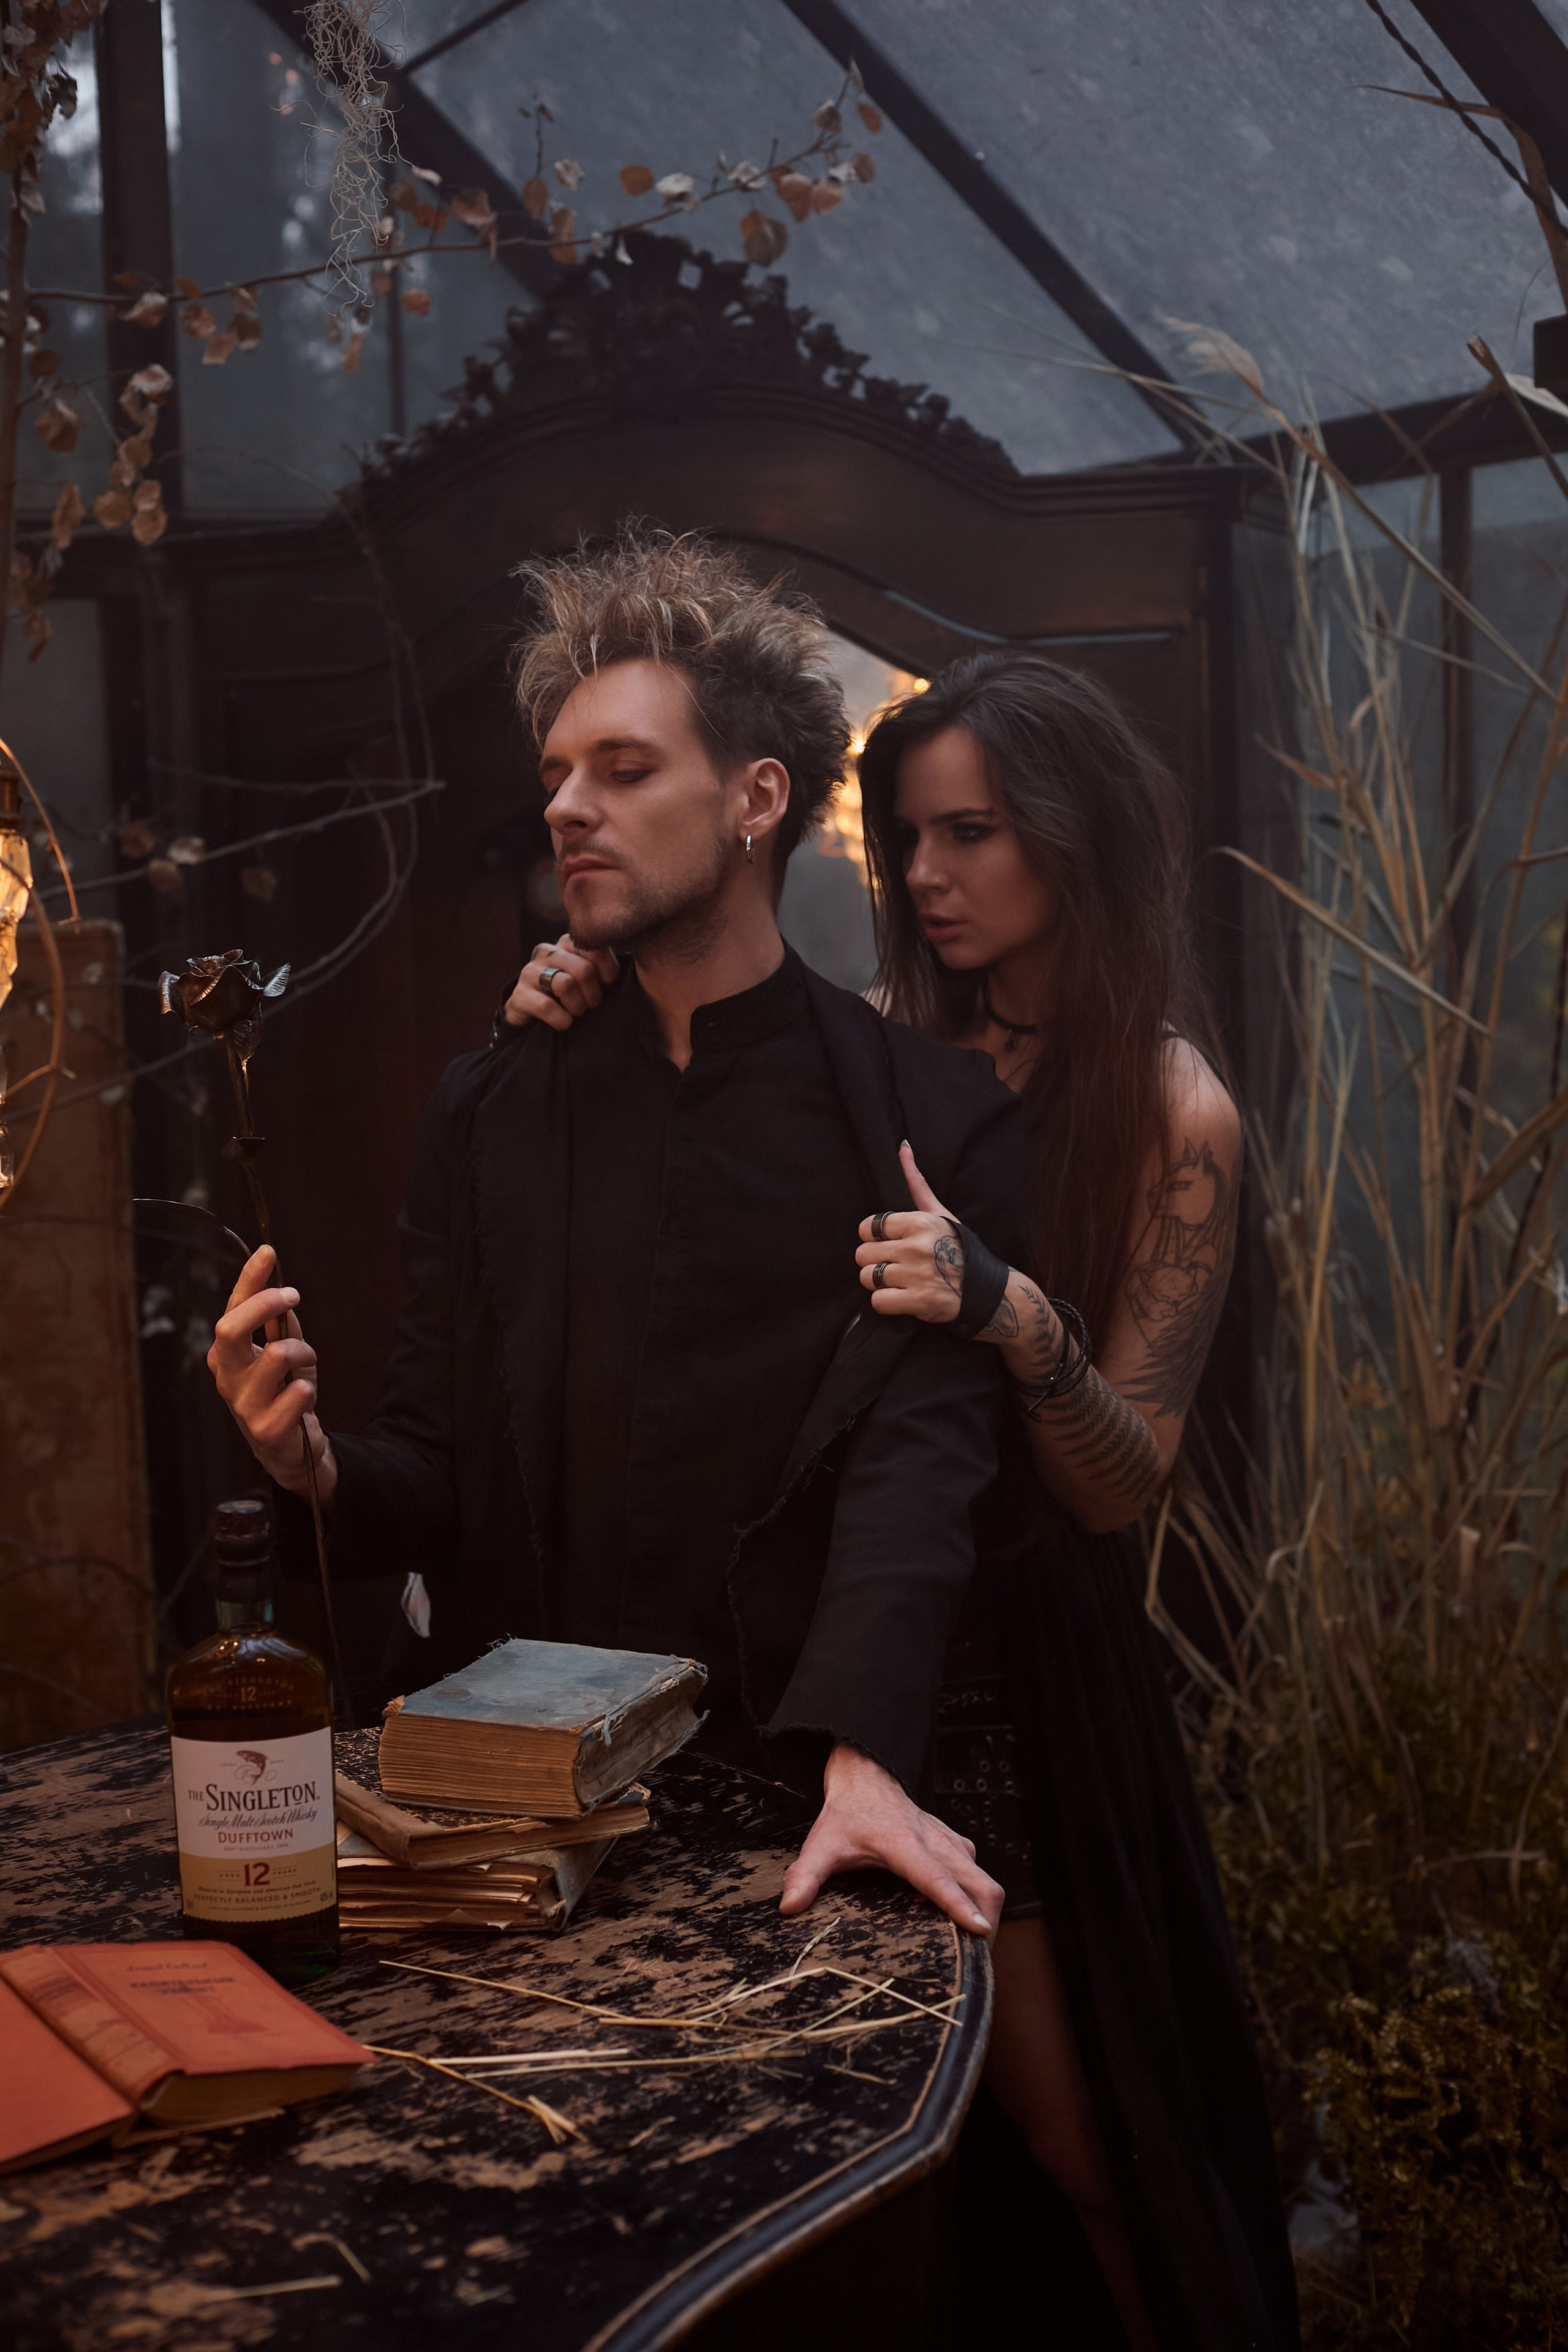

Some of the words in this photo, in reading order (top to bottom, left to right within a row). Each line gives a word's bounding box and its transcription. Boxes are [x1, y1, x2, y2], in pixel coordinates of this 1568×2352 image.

[241, 1686, 257, 1702] 12
[188, 1790, 204, 1801] THE
[198, 1813, 229, 1831] Single
[228, 1814, 254, 1828] Malt
[253, 1812, 286, 1828] Scotch
[285, 1807, 318, 1823] Whisky
[218, 1828, 293, 1844] DUFFTOWN
[244, 1862, 270, 1887] 12
[194, 1893, 232, 1904] PERFECTLY
[235, 1894, 279, 1904] BALANCED
[290, 1887, 322, 1899] SMOOTH
